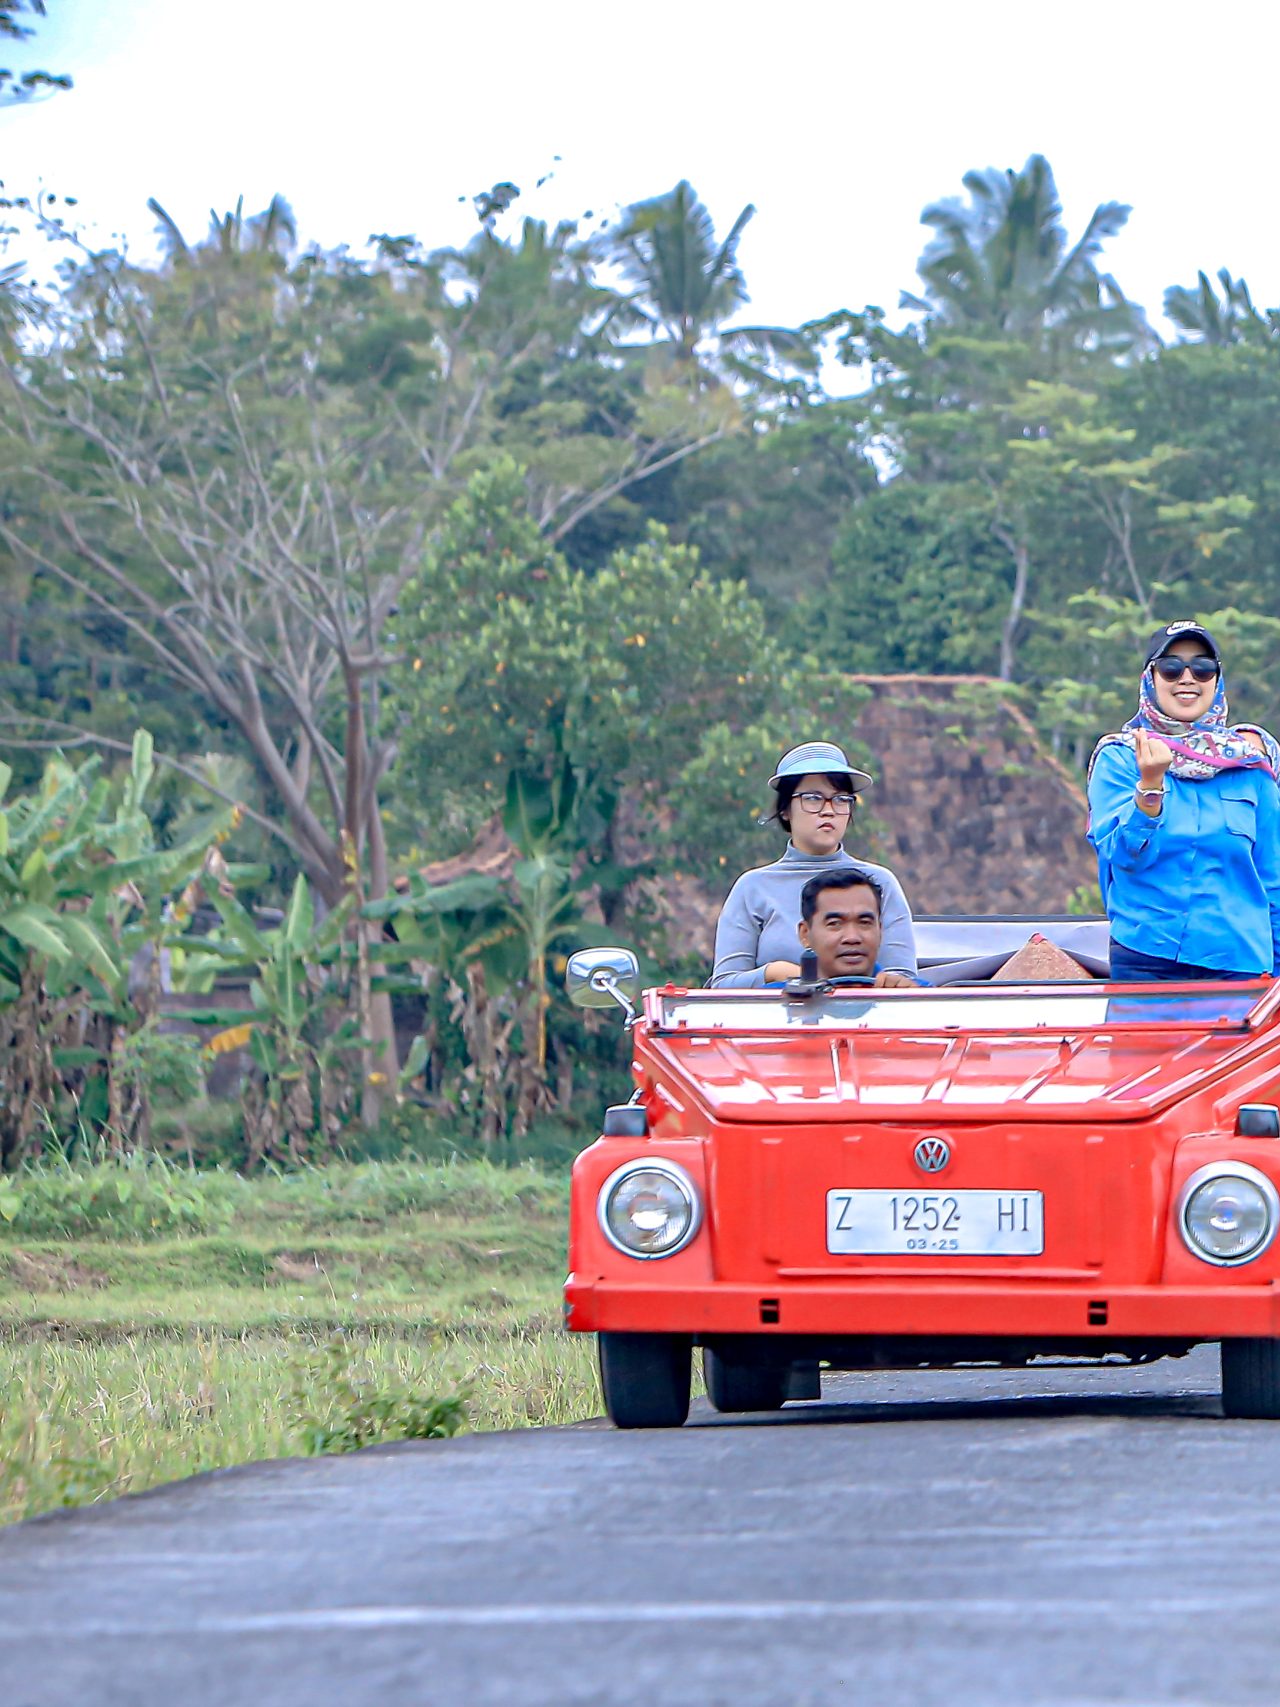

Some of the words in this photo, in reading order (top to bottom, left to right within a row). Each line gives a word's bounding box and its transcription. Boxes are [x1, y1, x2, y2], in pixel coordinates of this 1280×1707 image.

[835, 1196, 853, 1231] Z
[890, 1196, 961, 1231] 1252
[997, 1197, 1029, 1232] HI
